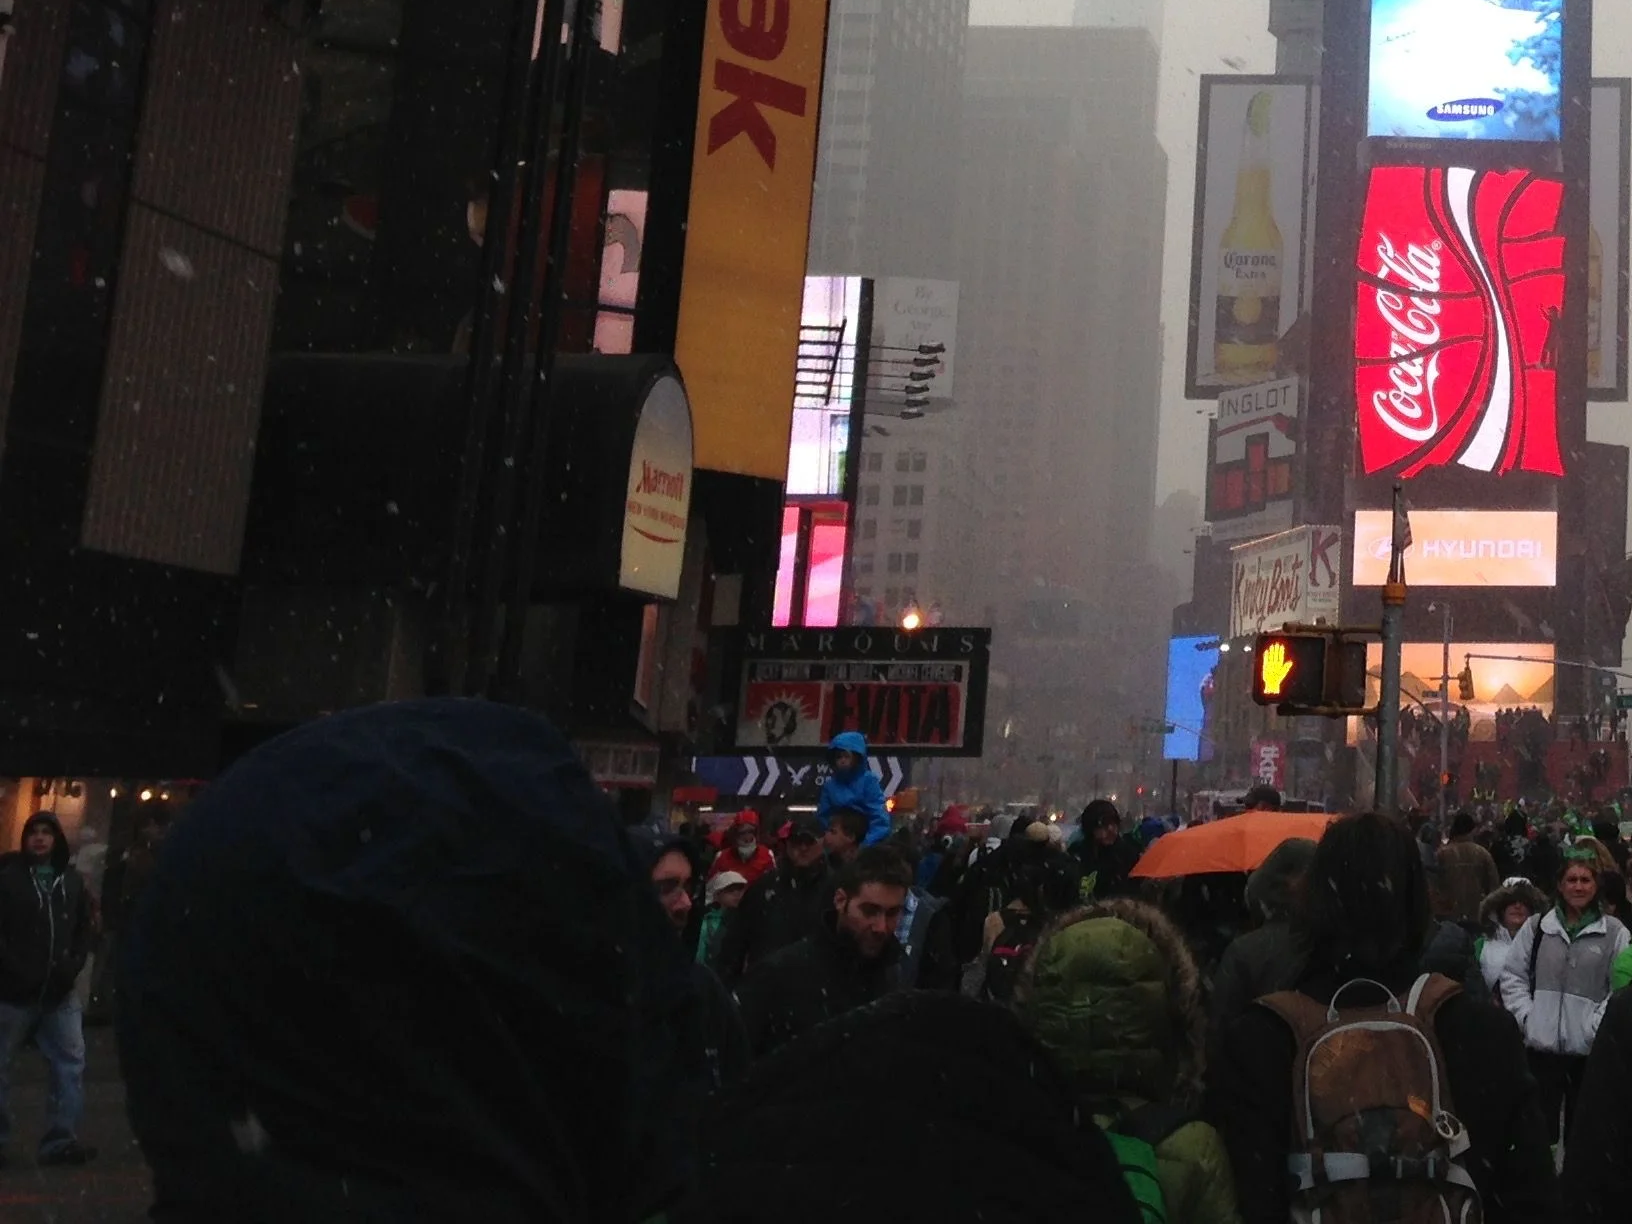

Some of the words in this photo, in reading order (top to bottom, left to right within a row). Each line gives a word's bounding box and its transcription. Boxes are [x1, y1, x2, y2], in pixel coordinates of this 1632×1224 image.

[1436, 103, 1495, 116] SAMSUNG
[1224, 252, 1277, 271] Corona
[1220, 385, 1290, 418] INGLOT
[1423, 538, 1542, 561] HYUNDAI
[1233, 556, 1268, 636] Kinky
[832, 683, 950, 744] EVITA
